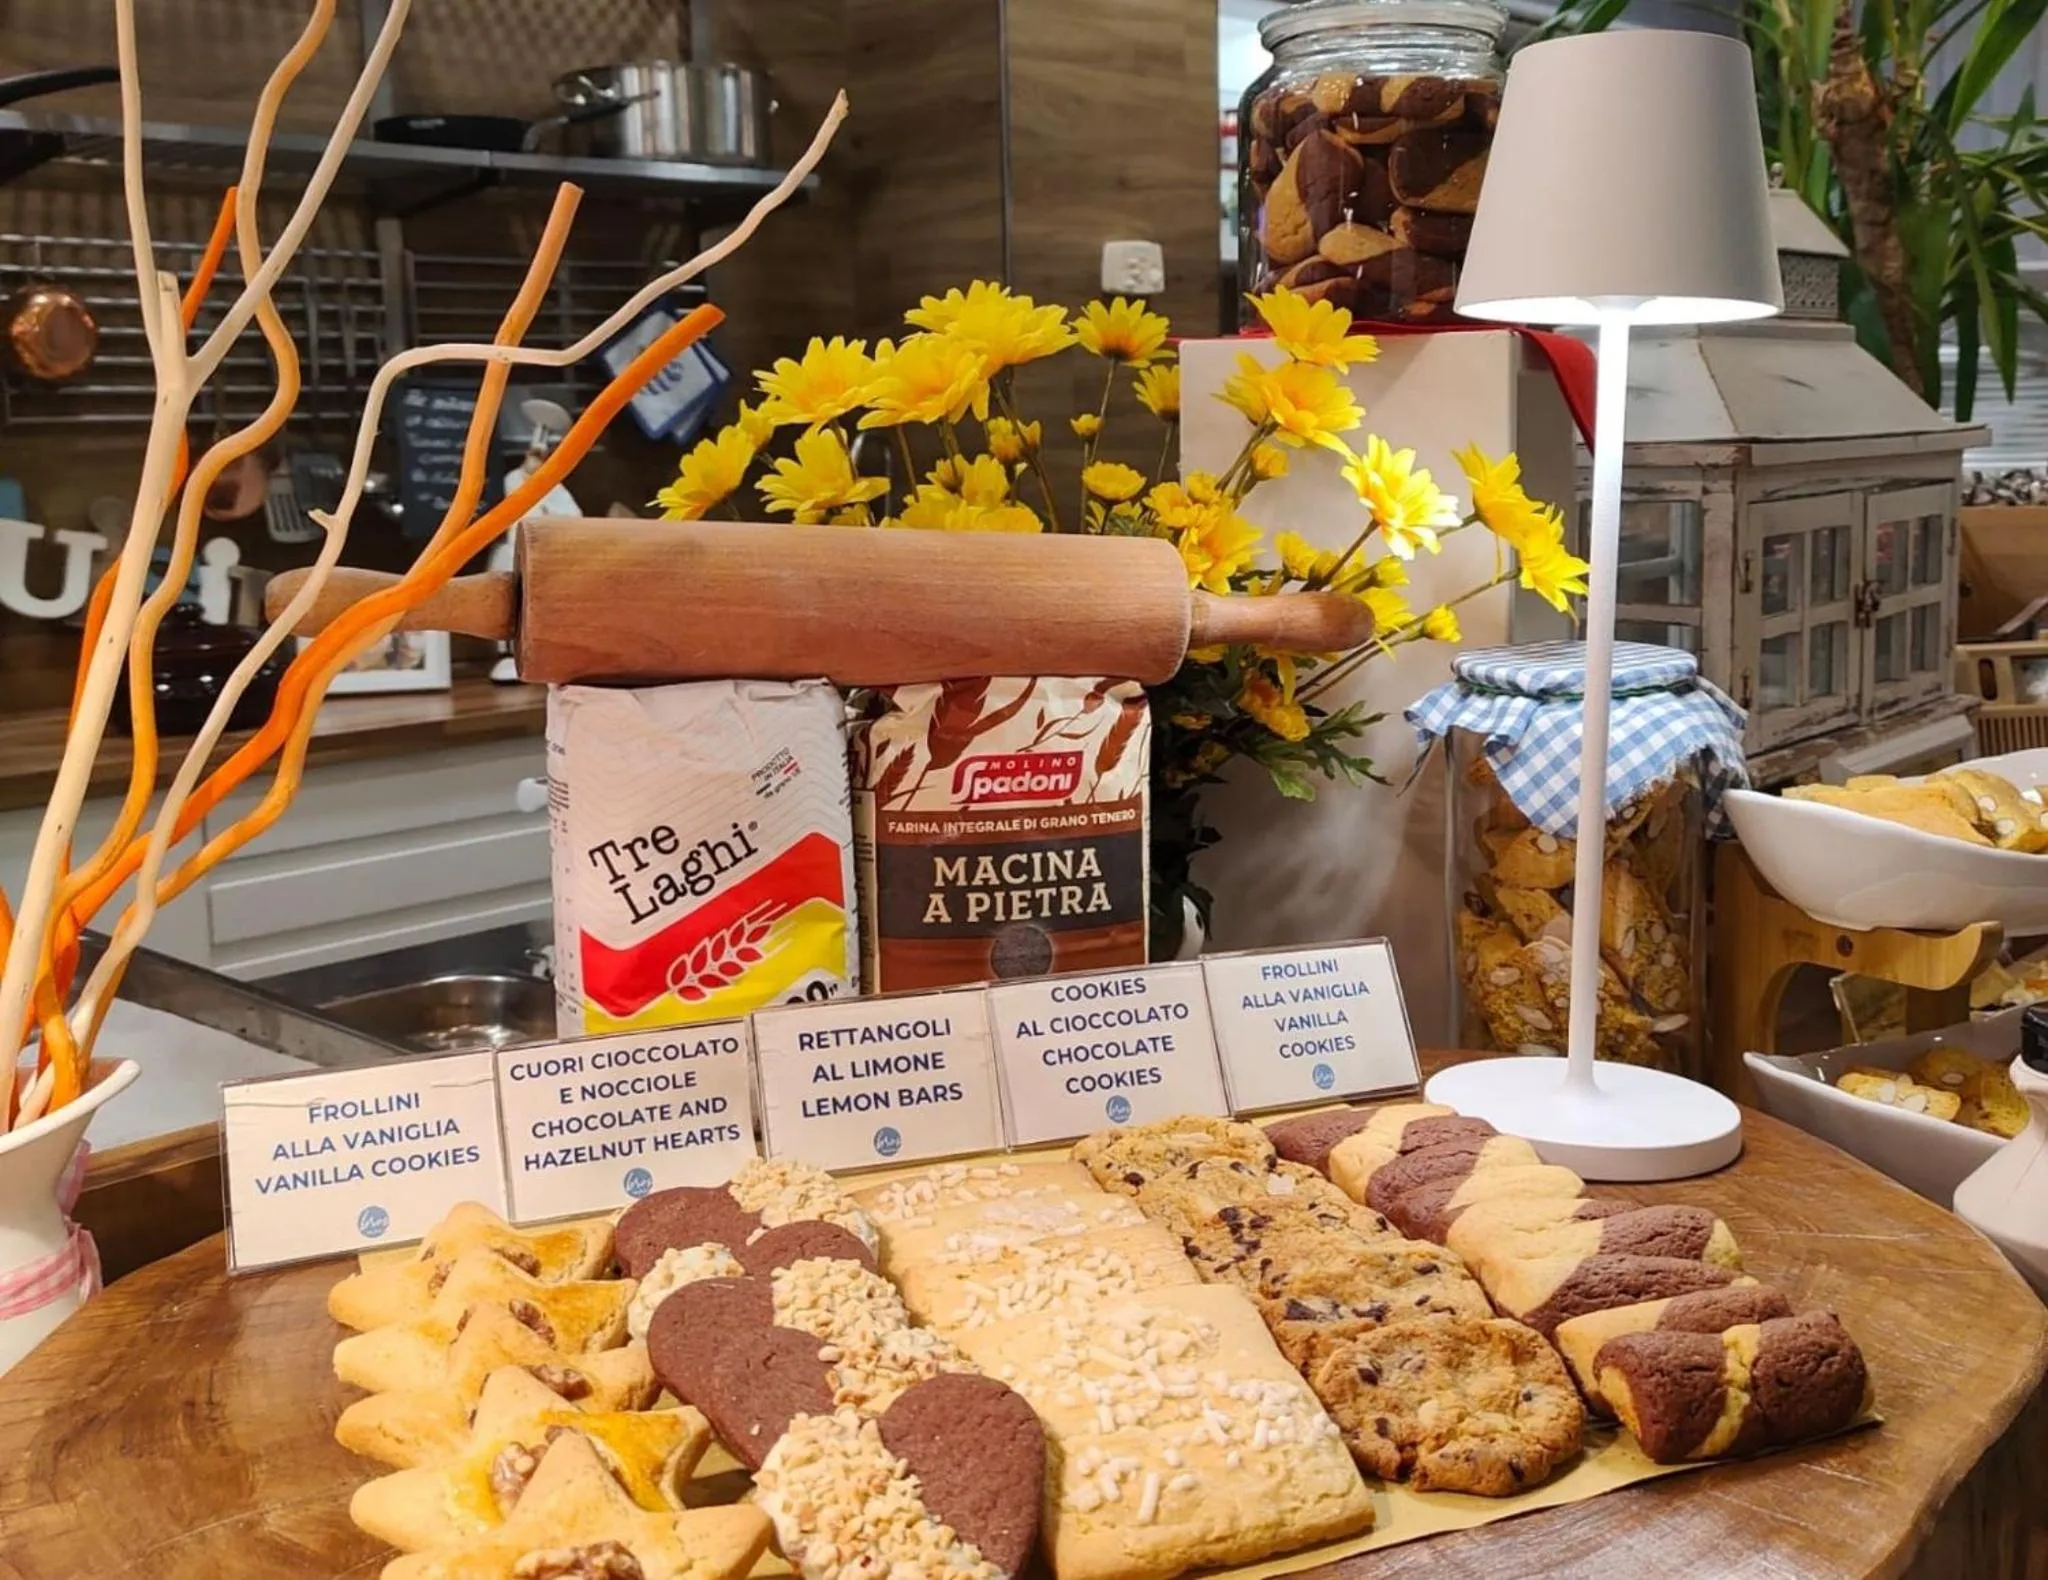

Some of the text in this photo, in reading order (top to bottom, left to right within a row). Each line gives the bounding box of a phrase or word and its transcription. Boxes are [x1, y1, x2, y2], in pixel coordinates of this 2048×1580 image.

[751, 747, 789, 781] PRODOTTO
[990, 756, 1077, 770] MOLINO
[952, 761, 1072, 800] Spadoni
[888, 808, 1136, 834] FARINA INTEGRALE DI GRANO TENERO
[588, 825, 679, 884] Tre
[933, 848, 1102, 887] MACINA
[922, 882, 1112, 923] A PIETRA
[1261, 959, 1338, 980] FROLLINI
[1051, 978, 1146, 1002] COOKIES
[1242, 981, 1370, 1010] ALLA VANIGLIA
[798, 1018, 951, 1051] RETTANGOLI
[1016, 1003, 1188, 1038] AL CIOCCOLATO
[1274, 1010, 1348, 1032] VANILLA
[510, 1038, 739, 1080] CUORI CIOCCOLATO
[1042, 1035, 1175, 1066] CHOCOLATE
[1279, 1036, 1356, 1058] COOKIES
[812, 1052, 946, 1082] AL LIMONE
[1066, 1067, 1162, 1094] COOKIES
[560, 1072, 697, 1104] E NOCCIOLE
[802, 1083, 963, 1118] LEMON BARS
[309, 1092, 420, 1124] FROLLINI
[532, 1097, 727, 1138] CHOCOLATE AND
[272, 1118, 460, 1160] ALLA VANIGLIA
[524, 1124, 740, 1171] HAZELNUT HEARTS
[256, 1146, 480, 1194] VANILLA COOKIES
